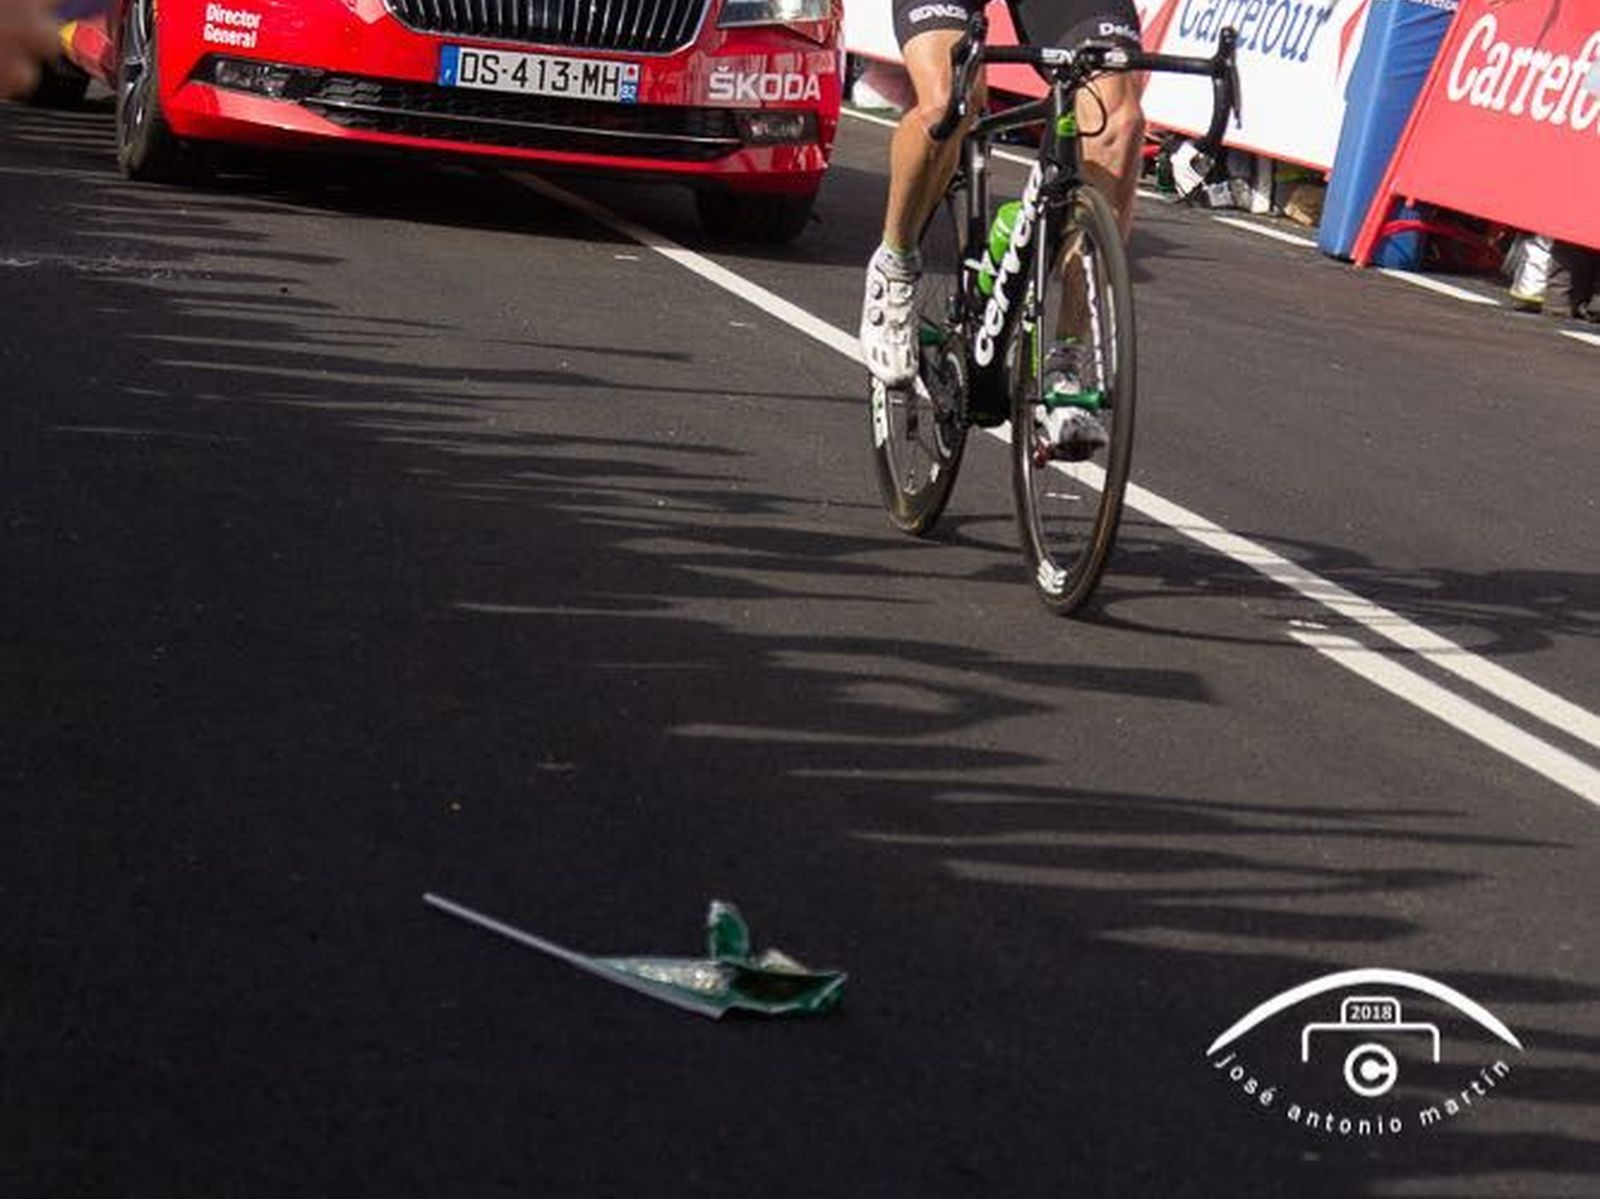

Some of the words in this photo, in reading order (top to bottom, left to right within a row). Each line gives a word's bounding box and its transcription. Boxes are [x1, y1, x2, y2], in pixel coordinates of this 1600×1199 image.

[205, 2, 263, 29] Director
[202, 23, 258, 49] General
[708, 64, 821, 101] ŠKODA
